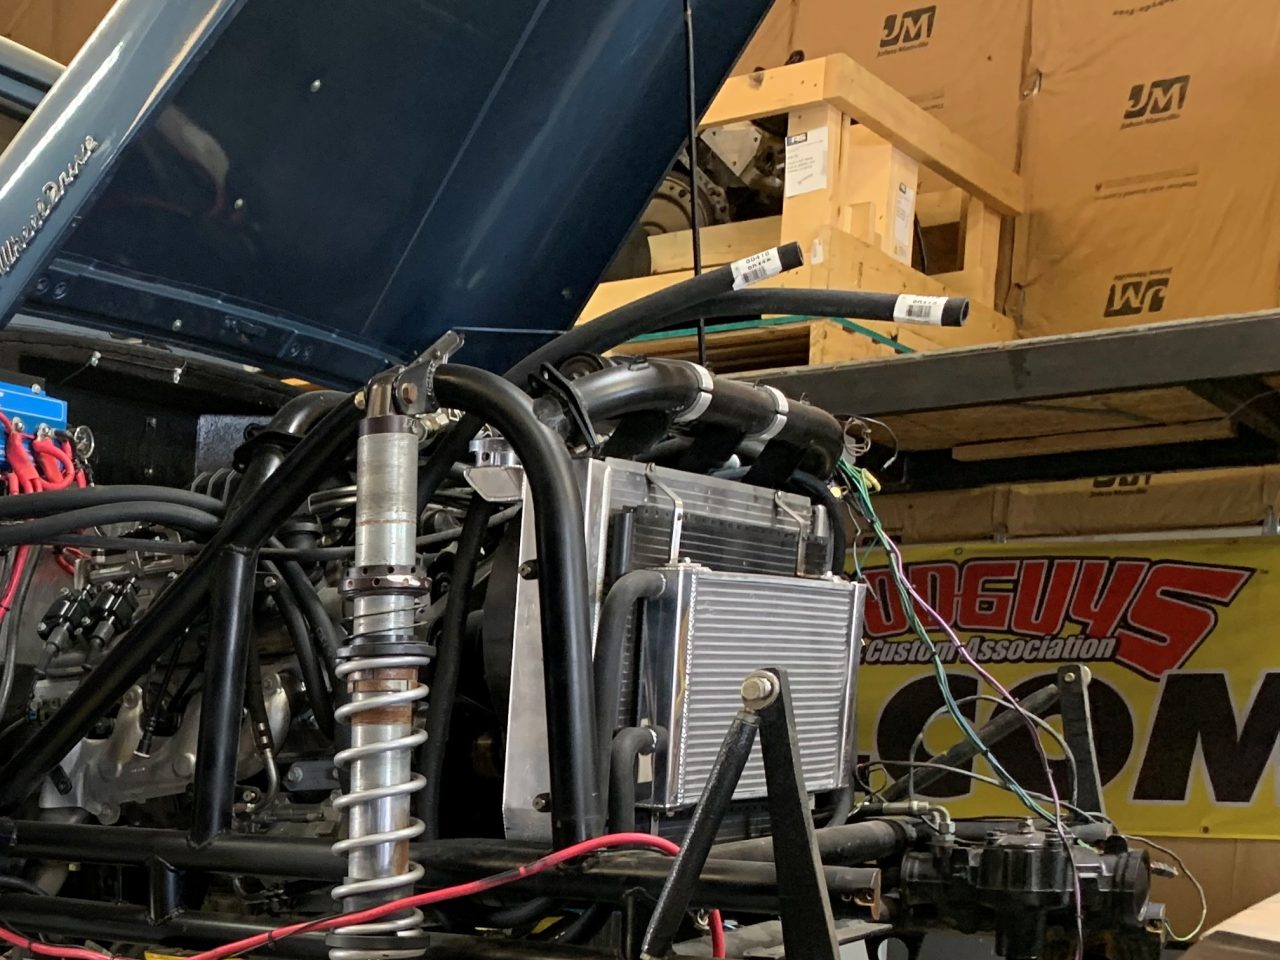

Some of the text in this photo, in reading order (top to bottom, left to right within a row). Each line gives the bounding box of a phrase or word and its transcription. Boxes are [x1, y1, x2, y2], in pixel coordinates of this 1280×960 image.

[880, 5, 937, 48] JM
[1123, 75, 1191, 119] JM
[864, 637, 1118, 663] Custom Association
